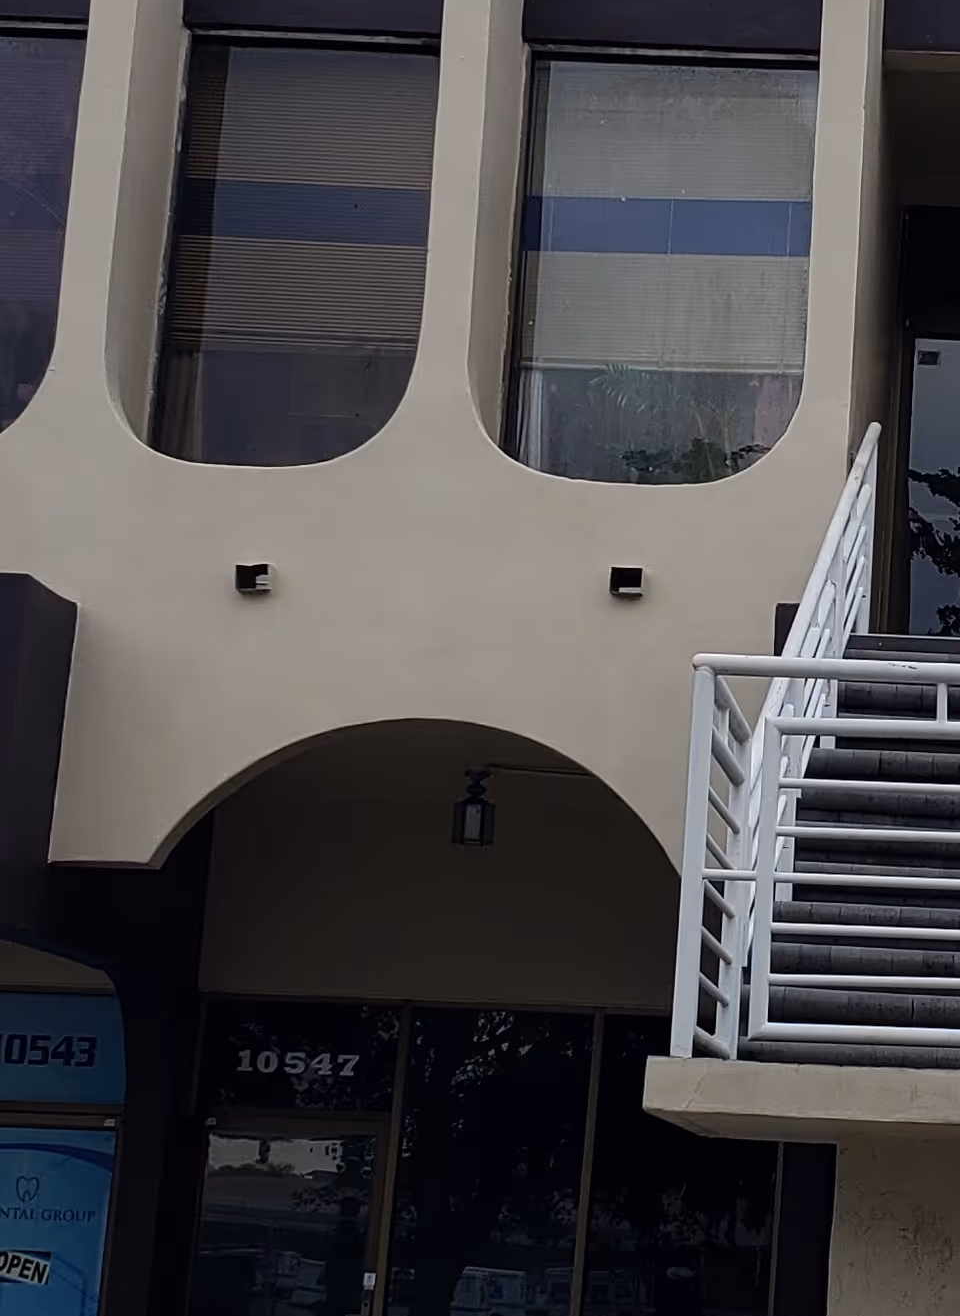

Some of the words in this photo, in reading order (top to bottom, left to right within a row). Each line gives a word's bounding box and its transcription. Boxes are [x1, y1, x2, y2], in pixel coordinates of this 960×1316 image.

[0, 1034, 97, 1068] 0543
[237, 1049, 360, 1076] 10547
[41, 1209, 97, 1223] GROUP
[0, 1250, 48, 1284] OPEN
